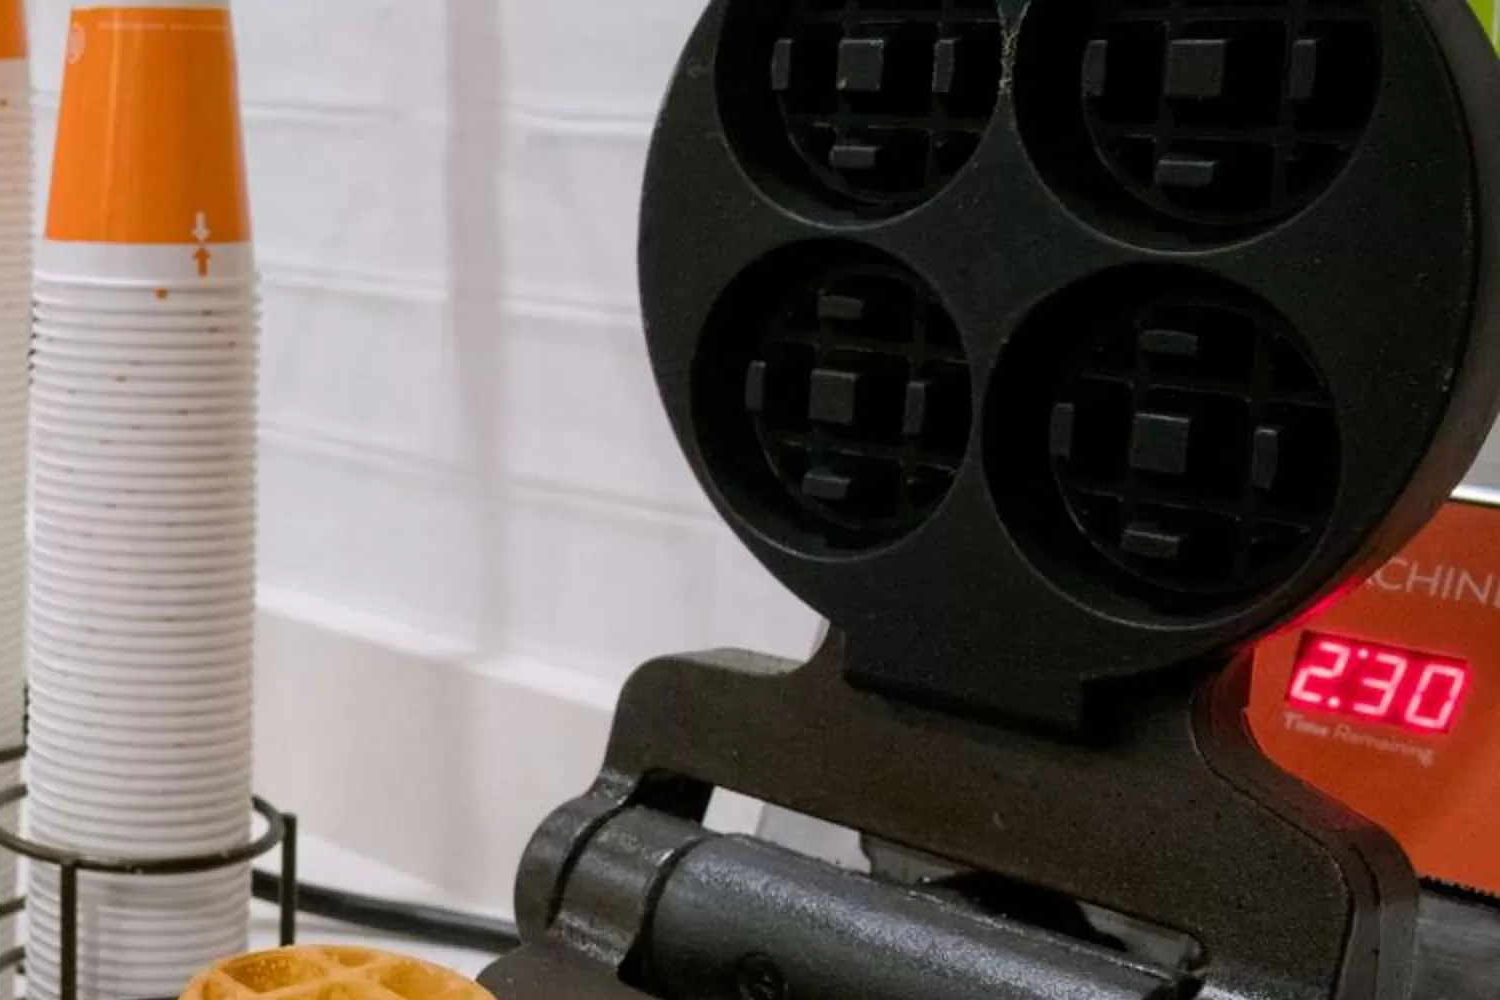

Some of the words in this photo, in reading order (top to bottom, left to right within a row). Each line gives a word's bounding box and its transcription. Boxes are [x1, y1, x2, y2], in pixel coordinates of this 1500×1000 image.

[1365, 555, 1500, 609] CHIN
[1289, 640, 1466, 730] 2:30
[1332, 723, 1435, 768] Remaining
